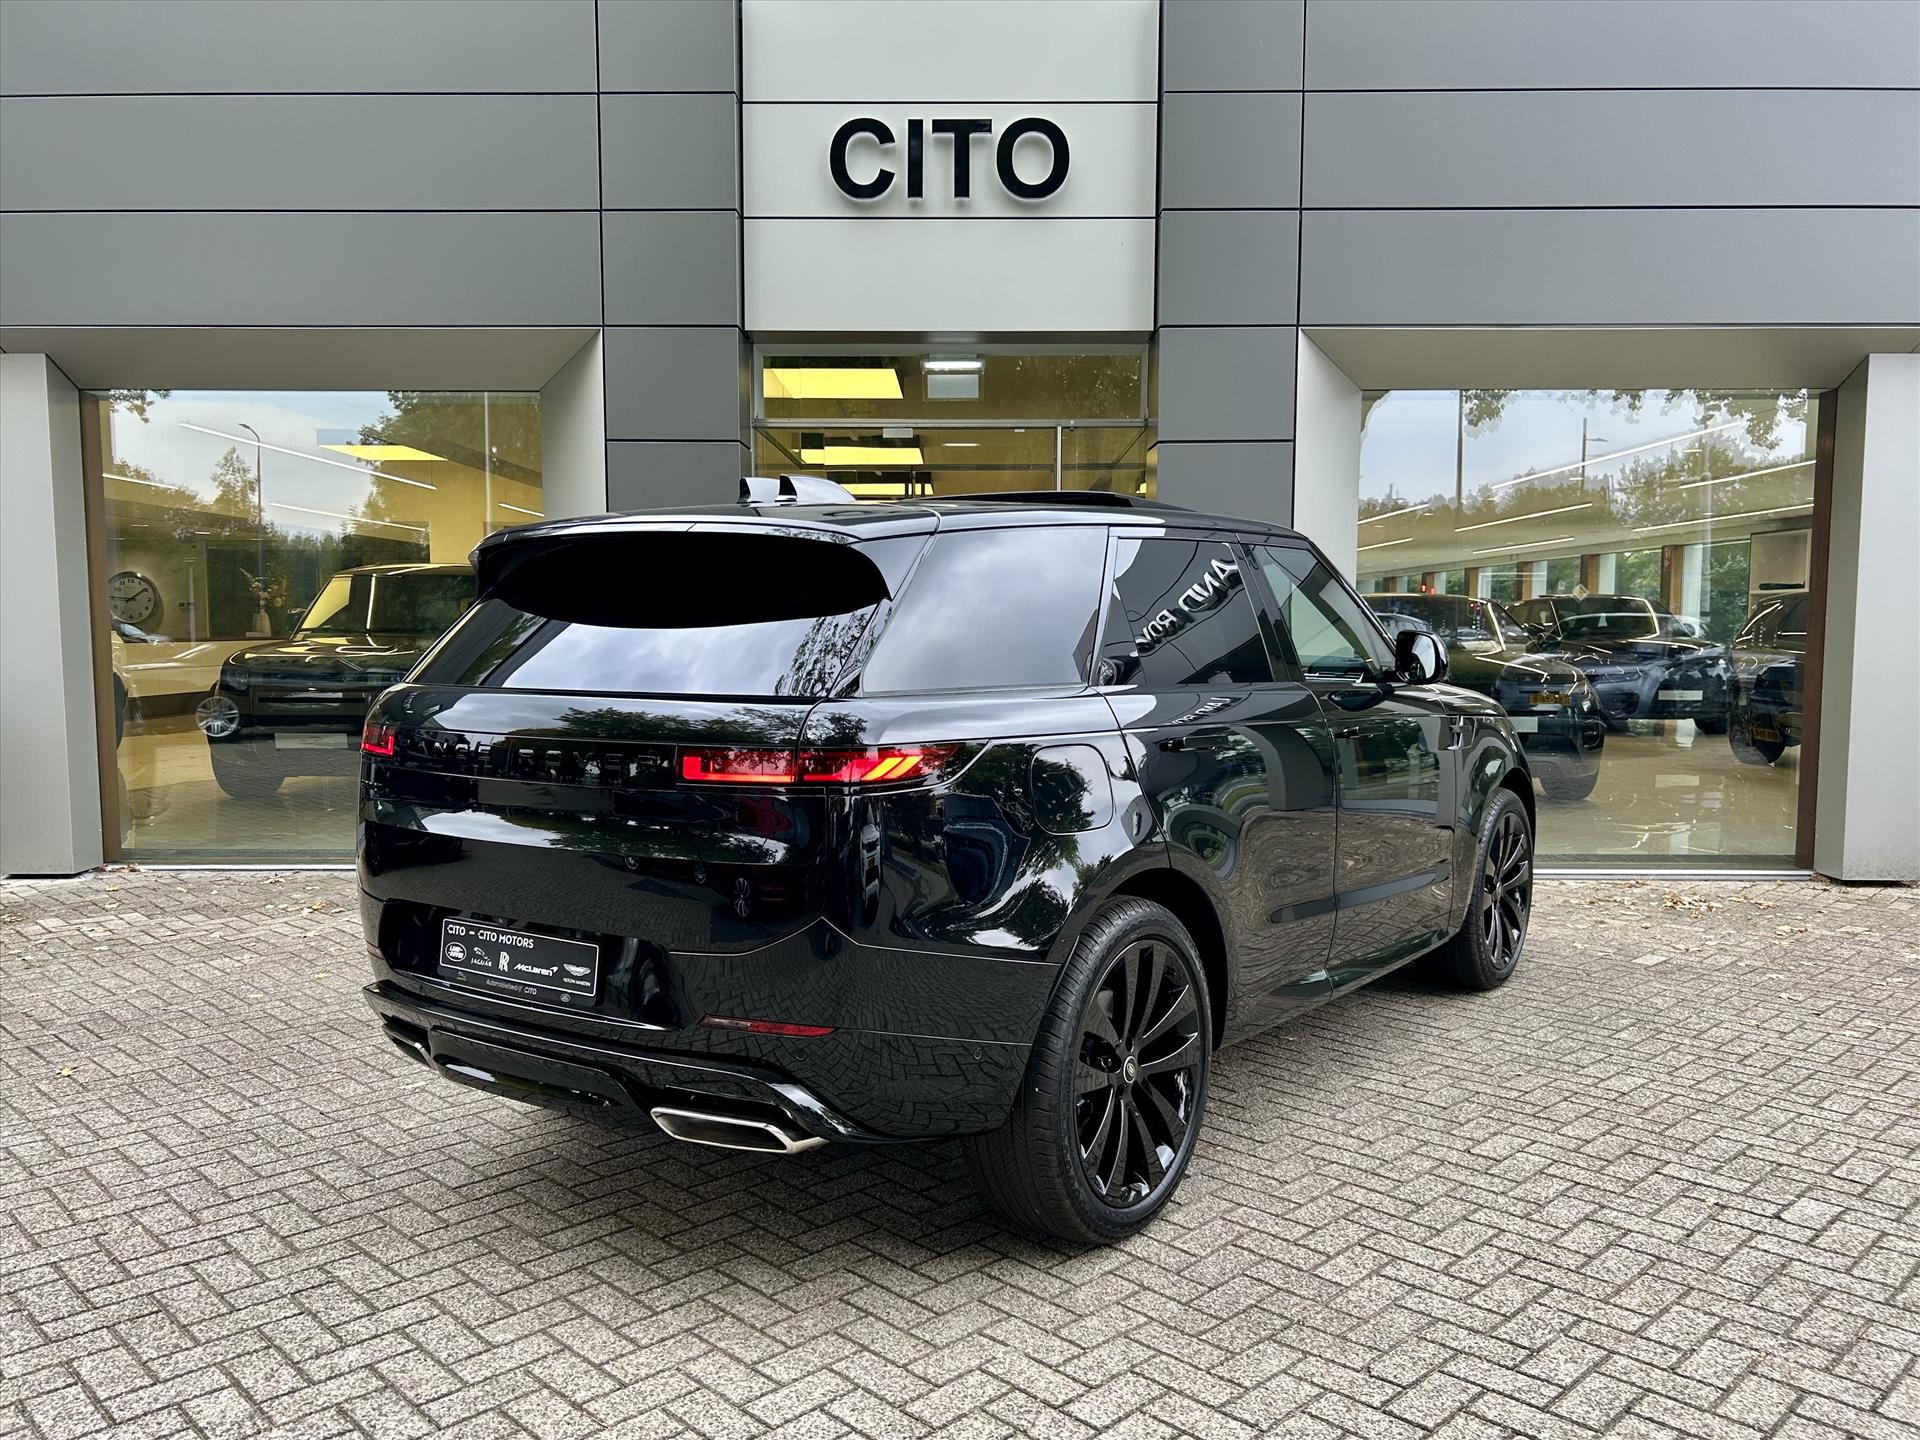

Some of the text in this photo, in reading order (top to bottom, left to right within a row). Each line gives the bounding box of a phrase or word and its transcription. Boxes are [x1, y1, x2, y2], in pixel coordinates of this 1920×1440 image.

[829, 117, 1070, 200] CITO
[446, 924, 466, 936] CITO
[477, 929, 498, 942] CITO
[498, 933, 534, 949] MOTORS
[470, 957, 493, 967] JAGUAR
[513, 963, 554, 977] McLaren
[523, 985, 538, 996] CITO
